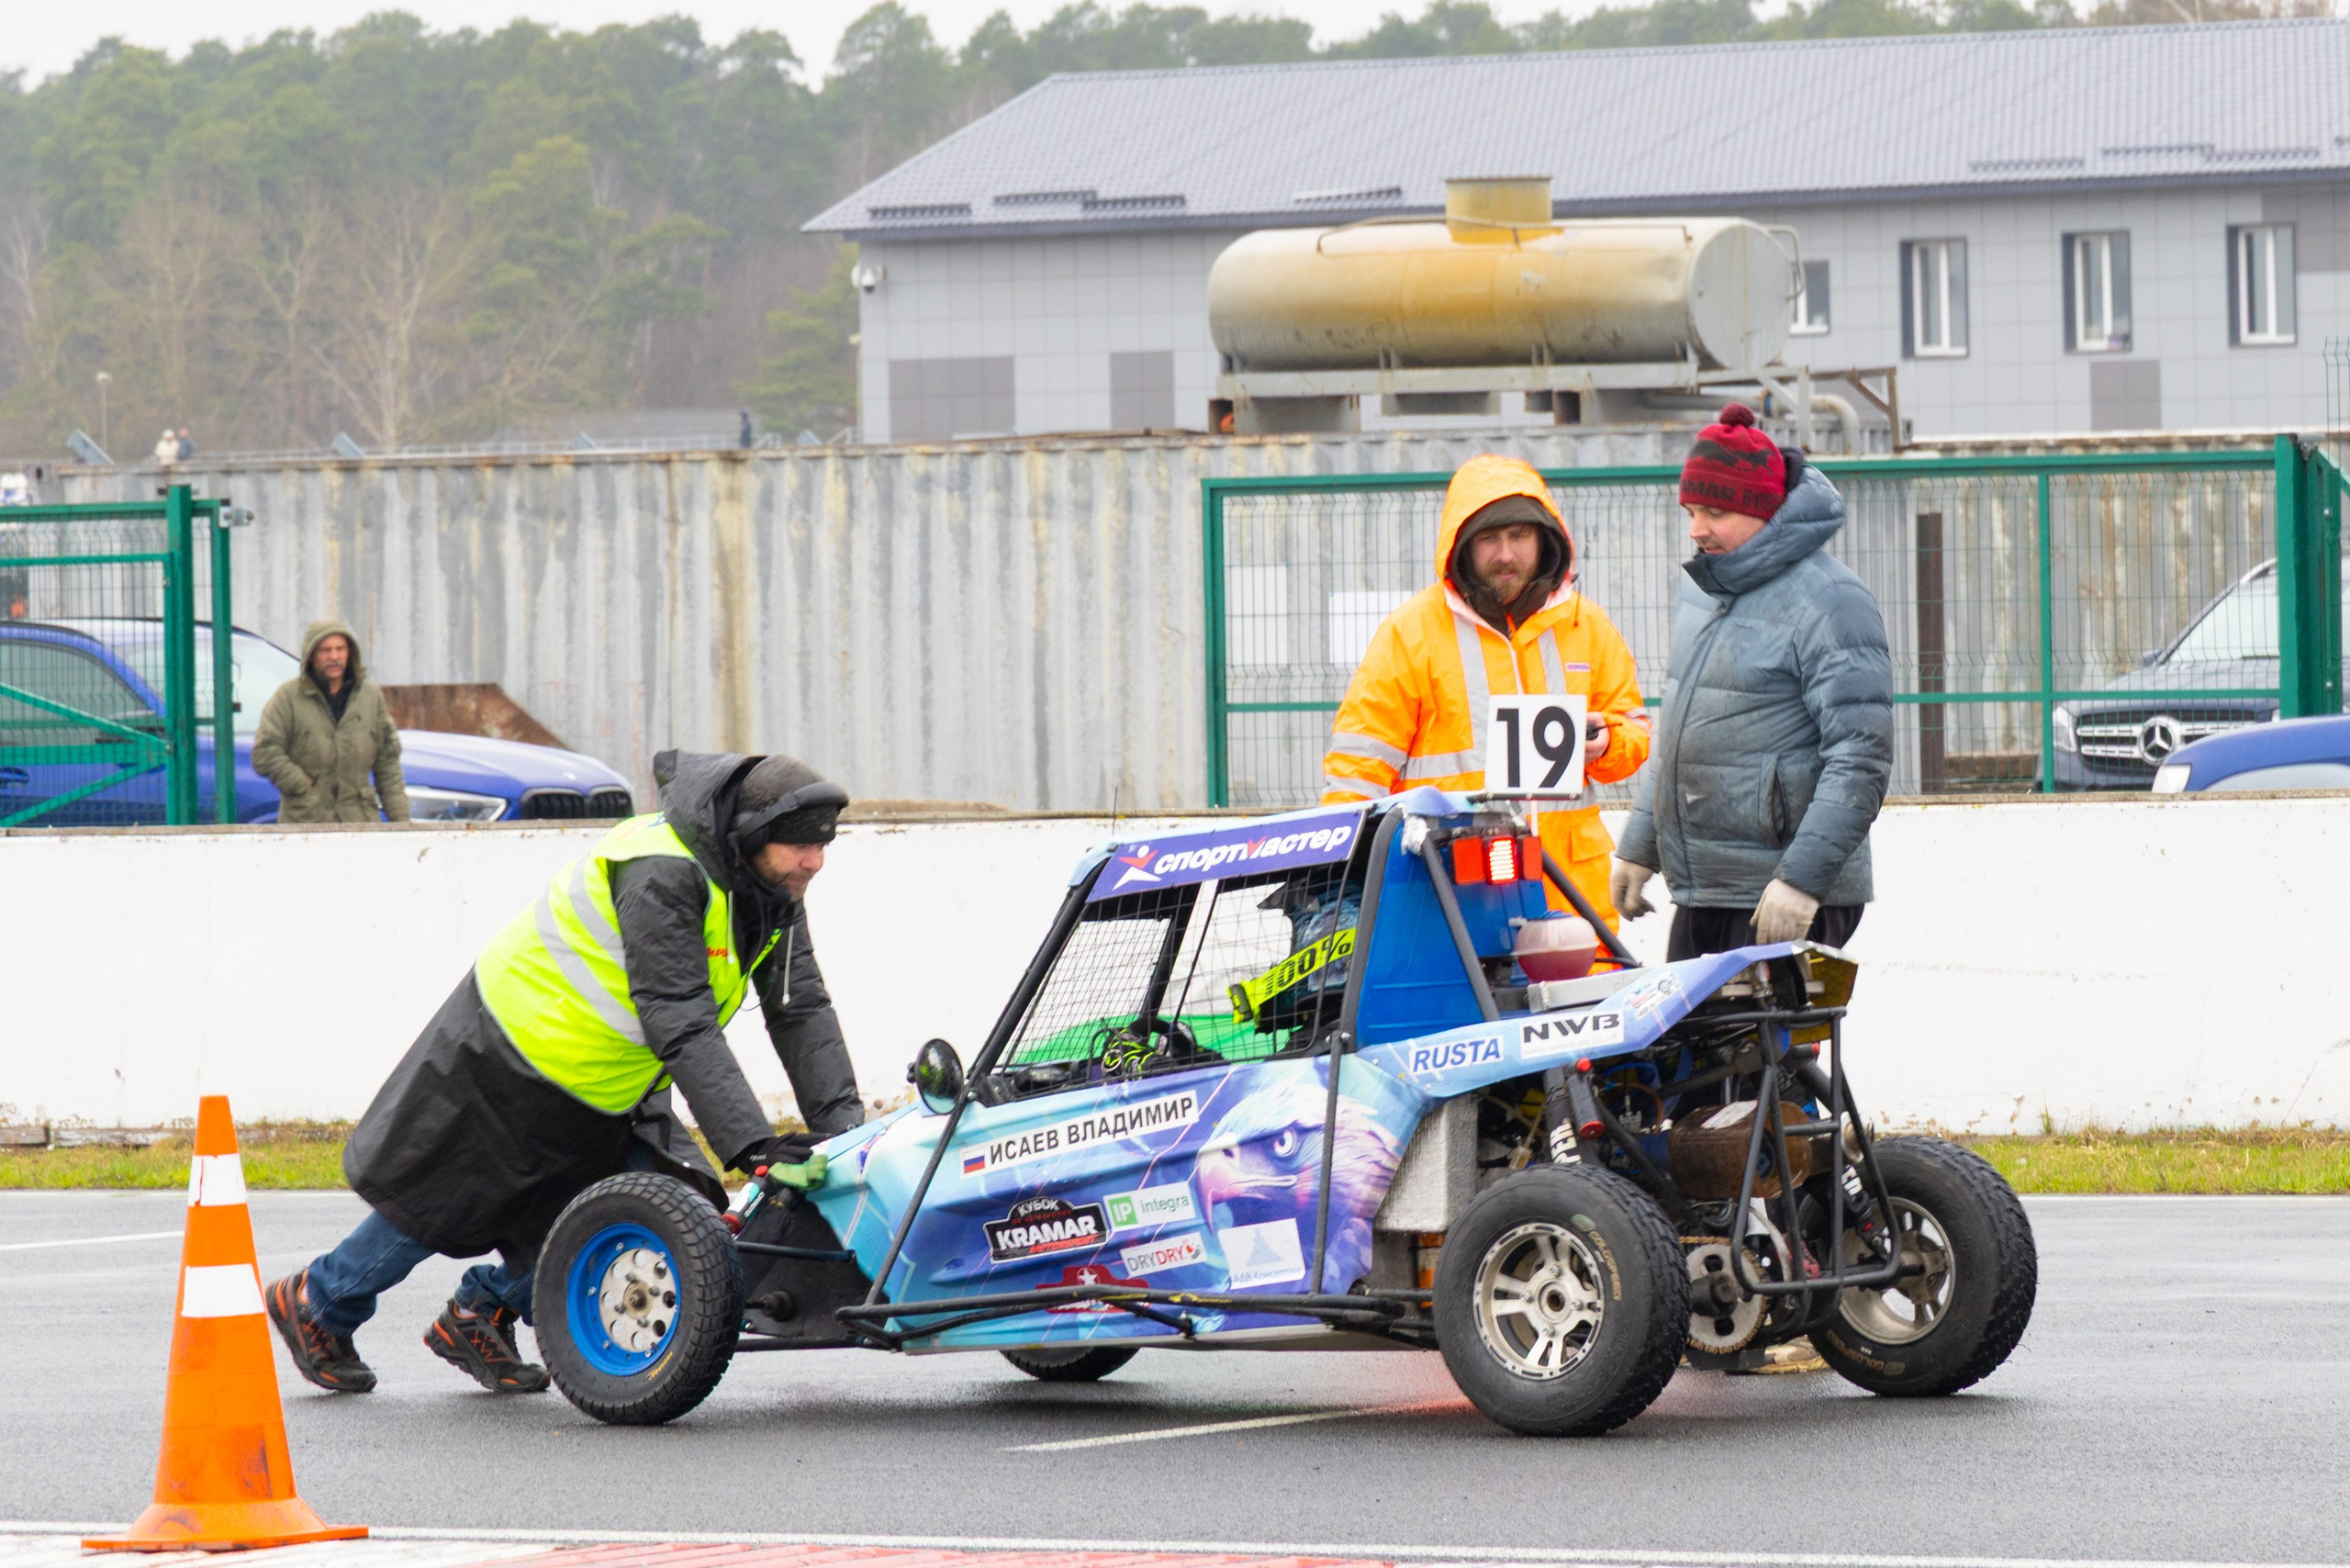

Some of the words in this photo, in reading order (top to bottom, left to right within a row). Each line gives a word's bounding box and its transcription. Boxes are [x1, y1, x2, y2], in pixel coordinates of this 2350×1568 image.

[1495, 705, 1577, 790] 19
[1262, 930, 1352, 997] 100%
[1523, 1014, 1620, 1044] NWB
[1412, 1037, 1501, 1072] RUSTA
[990, 1129, 1059, 1166] ИСАЕВ
[1068, 1096, 1193, 1145] ВЛАДИМИР
[1017, 1198, 1060, 1217] КУБОК
[1112, 1202, 1132, 1223] IP
[1139, 1195, 1189, 1214] integra
[995, 1215, 1099, 1251] KRAMAR
[1127, 1245, 1184, 1271] DRYDRY
